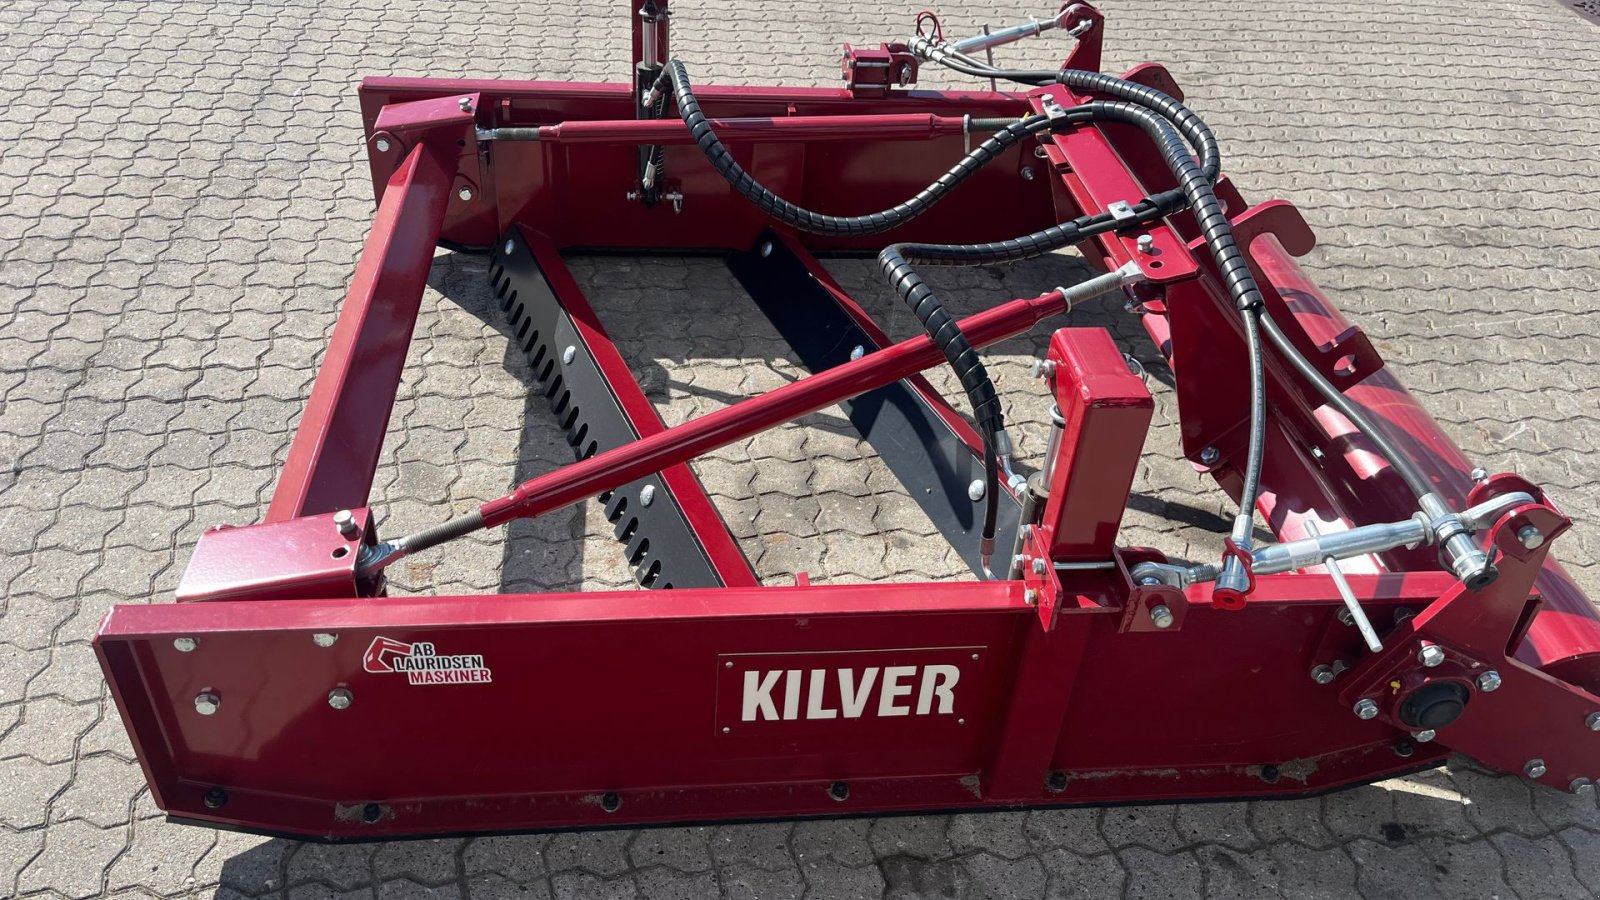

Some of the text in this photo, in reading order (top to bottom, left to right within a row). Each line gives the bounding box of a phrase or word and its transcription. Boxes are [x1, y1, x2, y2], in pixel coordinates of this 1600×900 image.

[413, 643, 433, 656] AB
[395, 656, 482, 671] LAURIDSEN
[410, 669, 490, 683] MASKINER
[742, 664, 960, 721] KILVER
